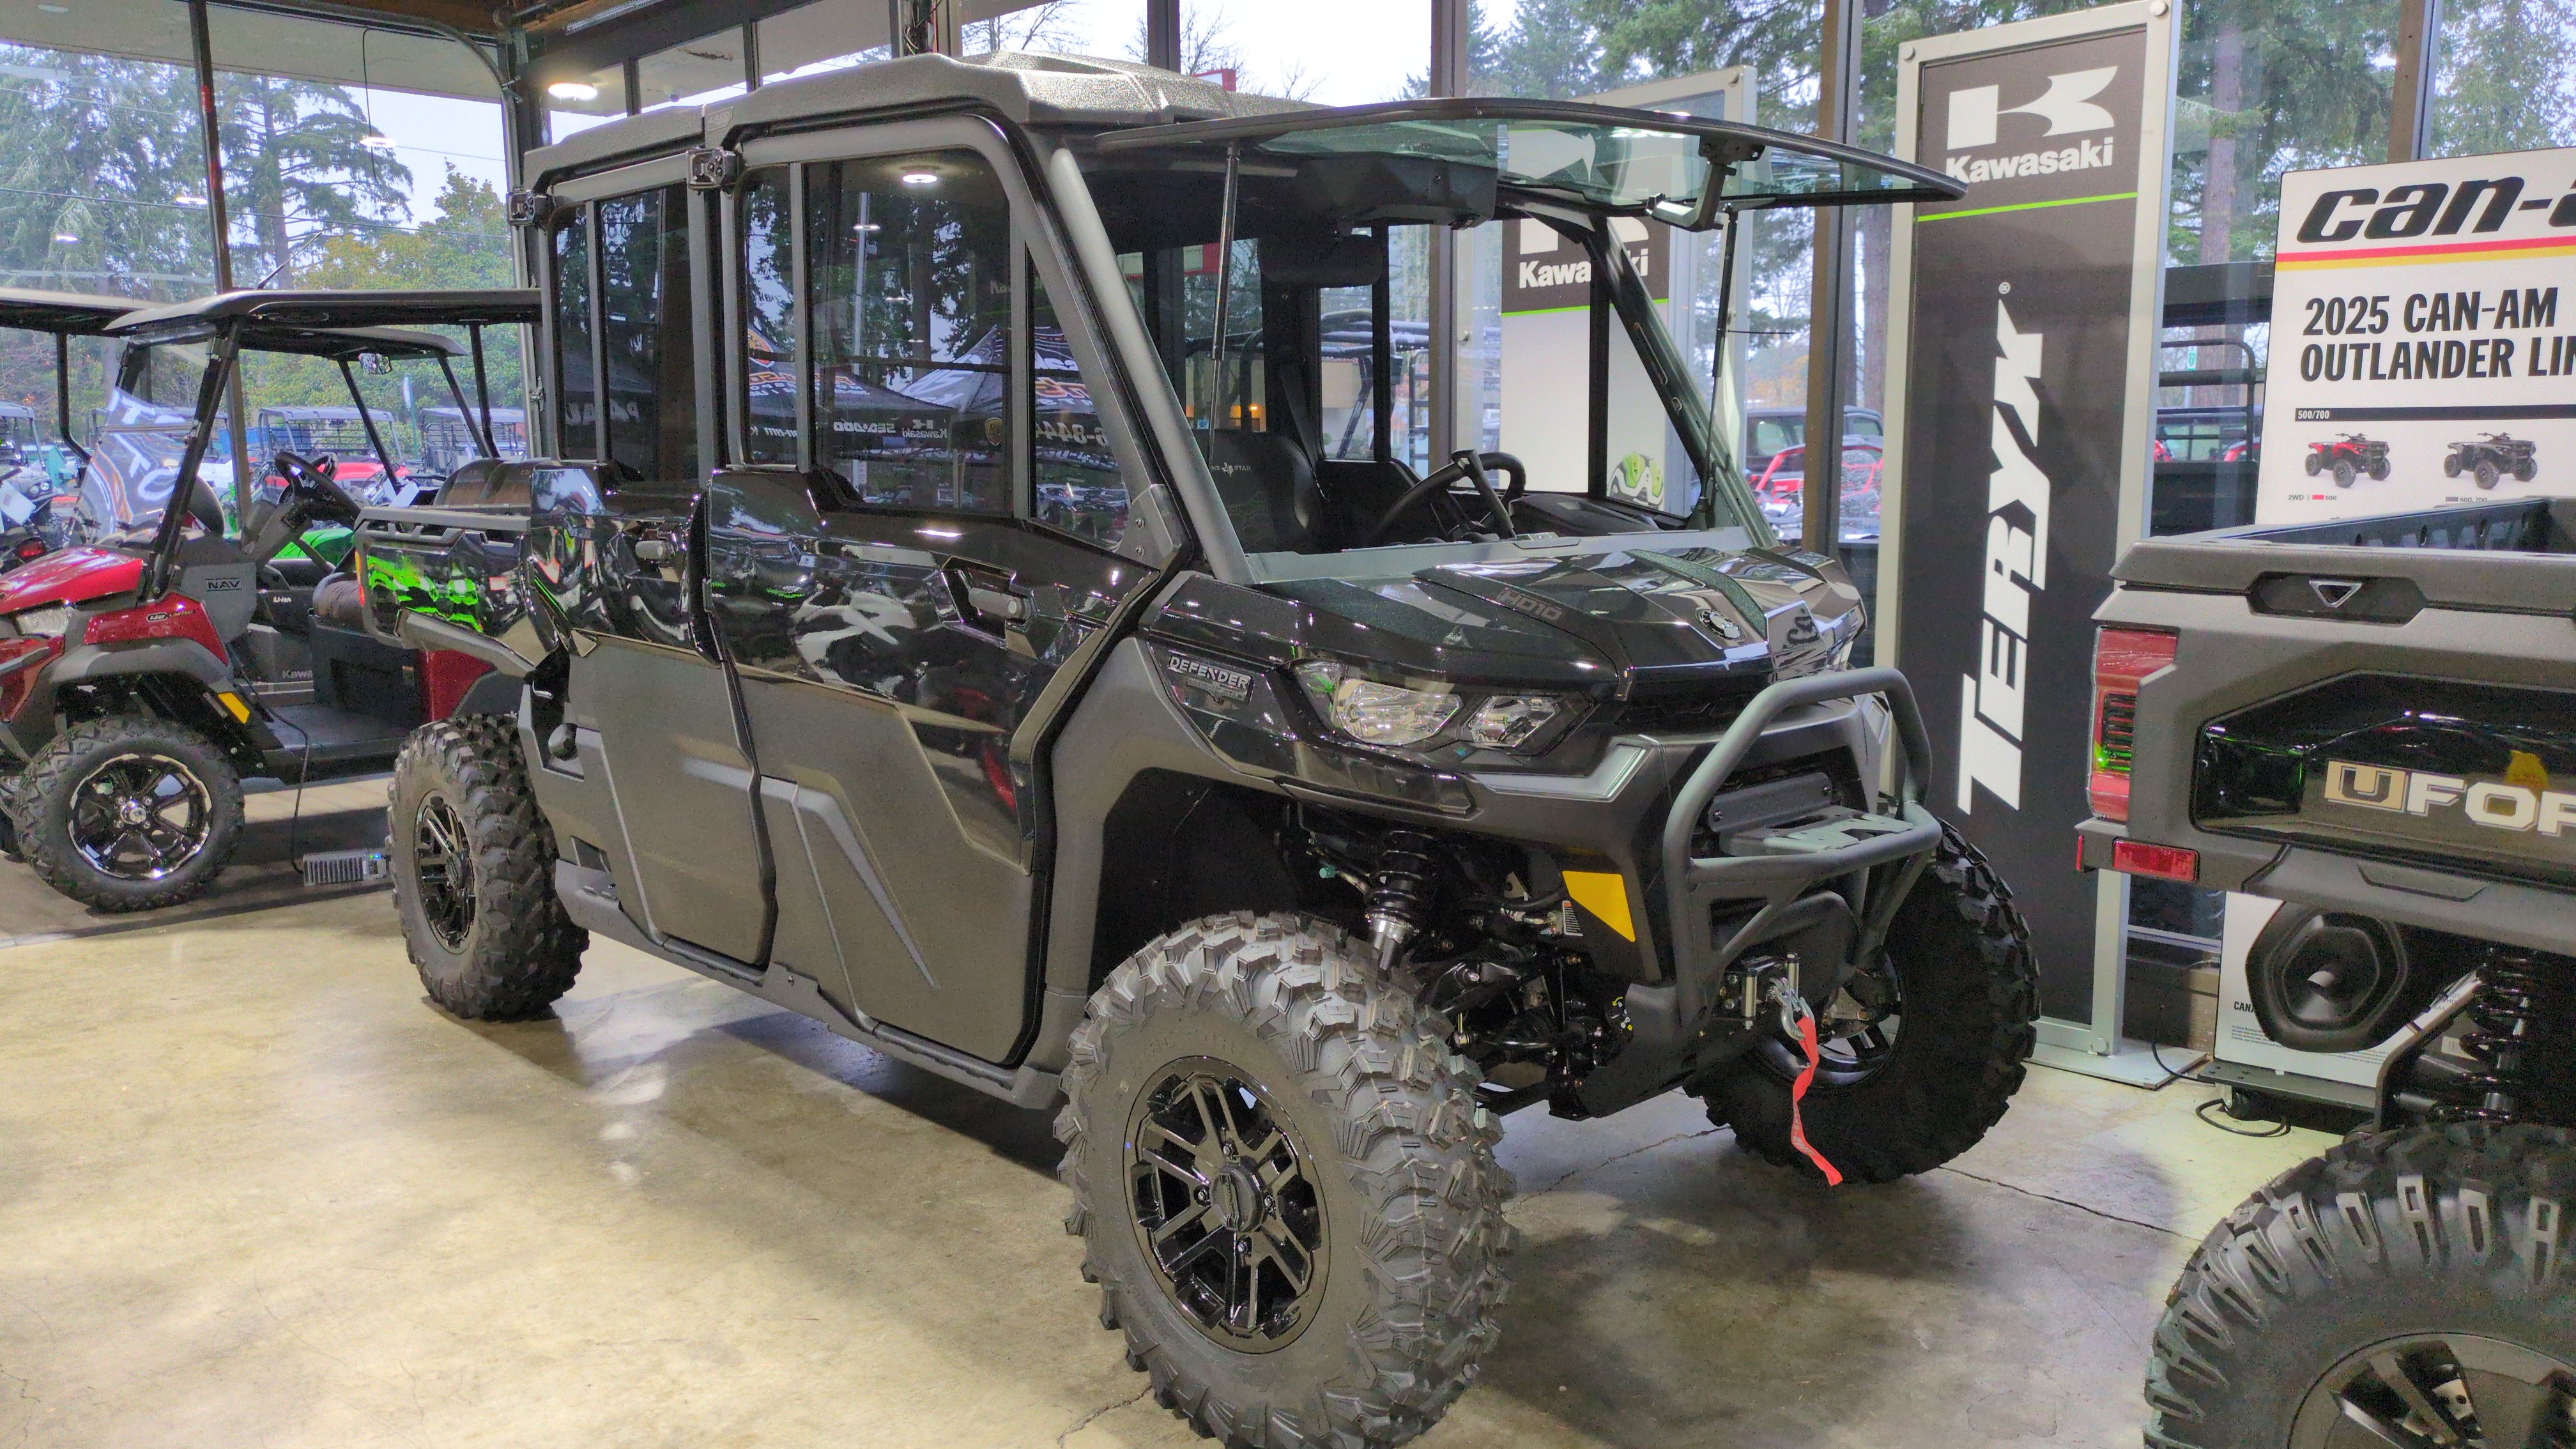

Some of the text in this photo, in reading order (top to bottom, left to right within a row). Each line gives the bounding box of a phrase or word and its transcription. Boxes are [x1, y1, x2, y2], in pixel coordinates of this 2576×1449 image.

[1946, 137, 2113, 183] Kawasaki
[2303, 287, 2558, 336] 2025 CAN-AM
[2300, 338, 2515, 382] OUTLANDER
[2297, 410, 2330, 420] 500/700
[208, 580, 240, 588] NAV
[1497, 590, 1563, 620] HD10
[1169, 656, 1250, 689] DEFENDER
